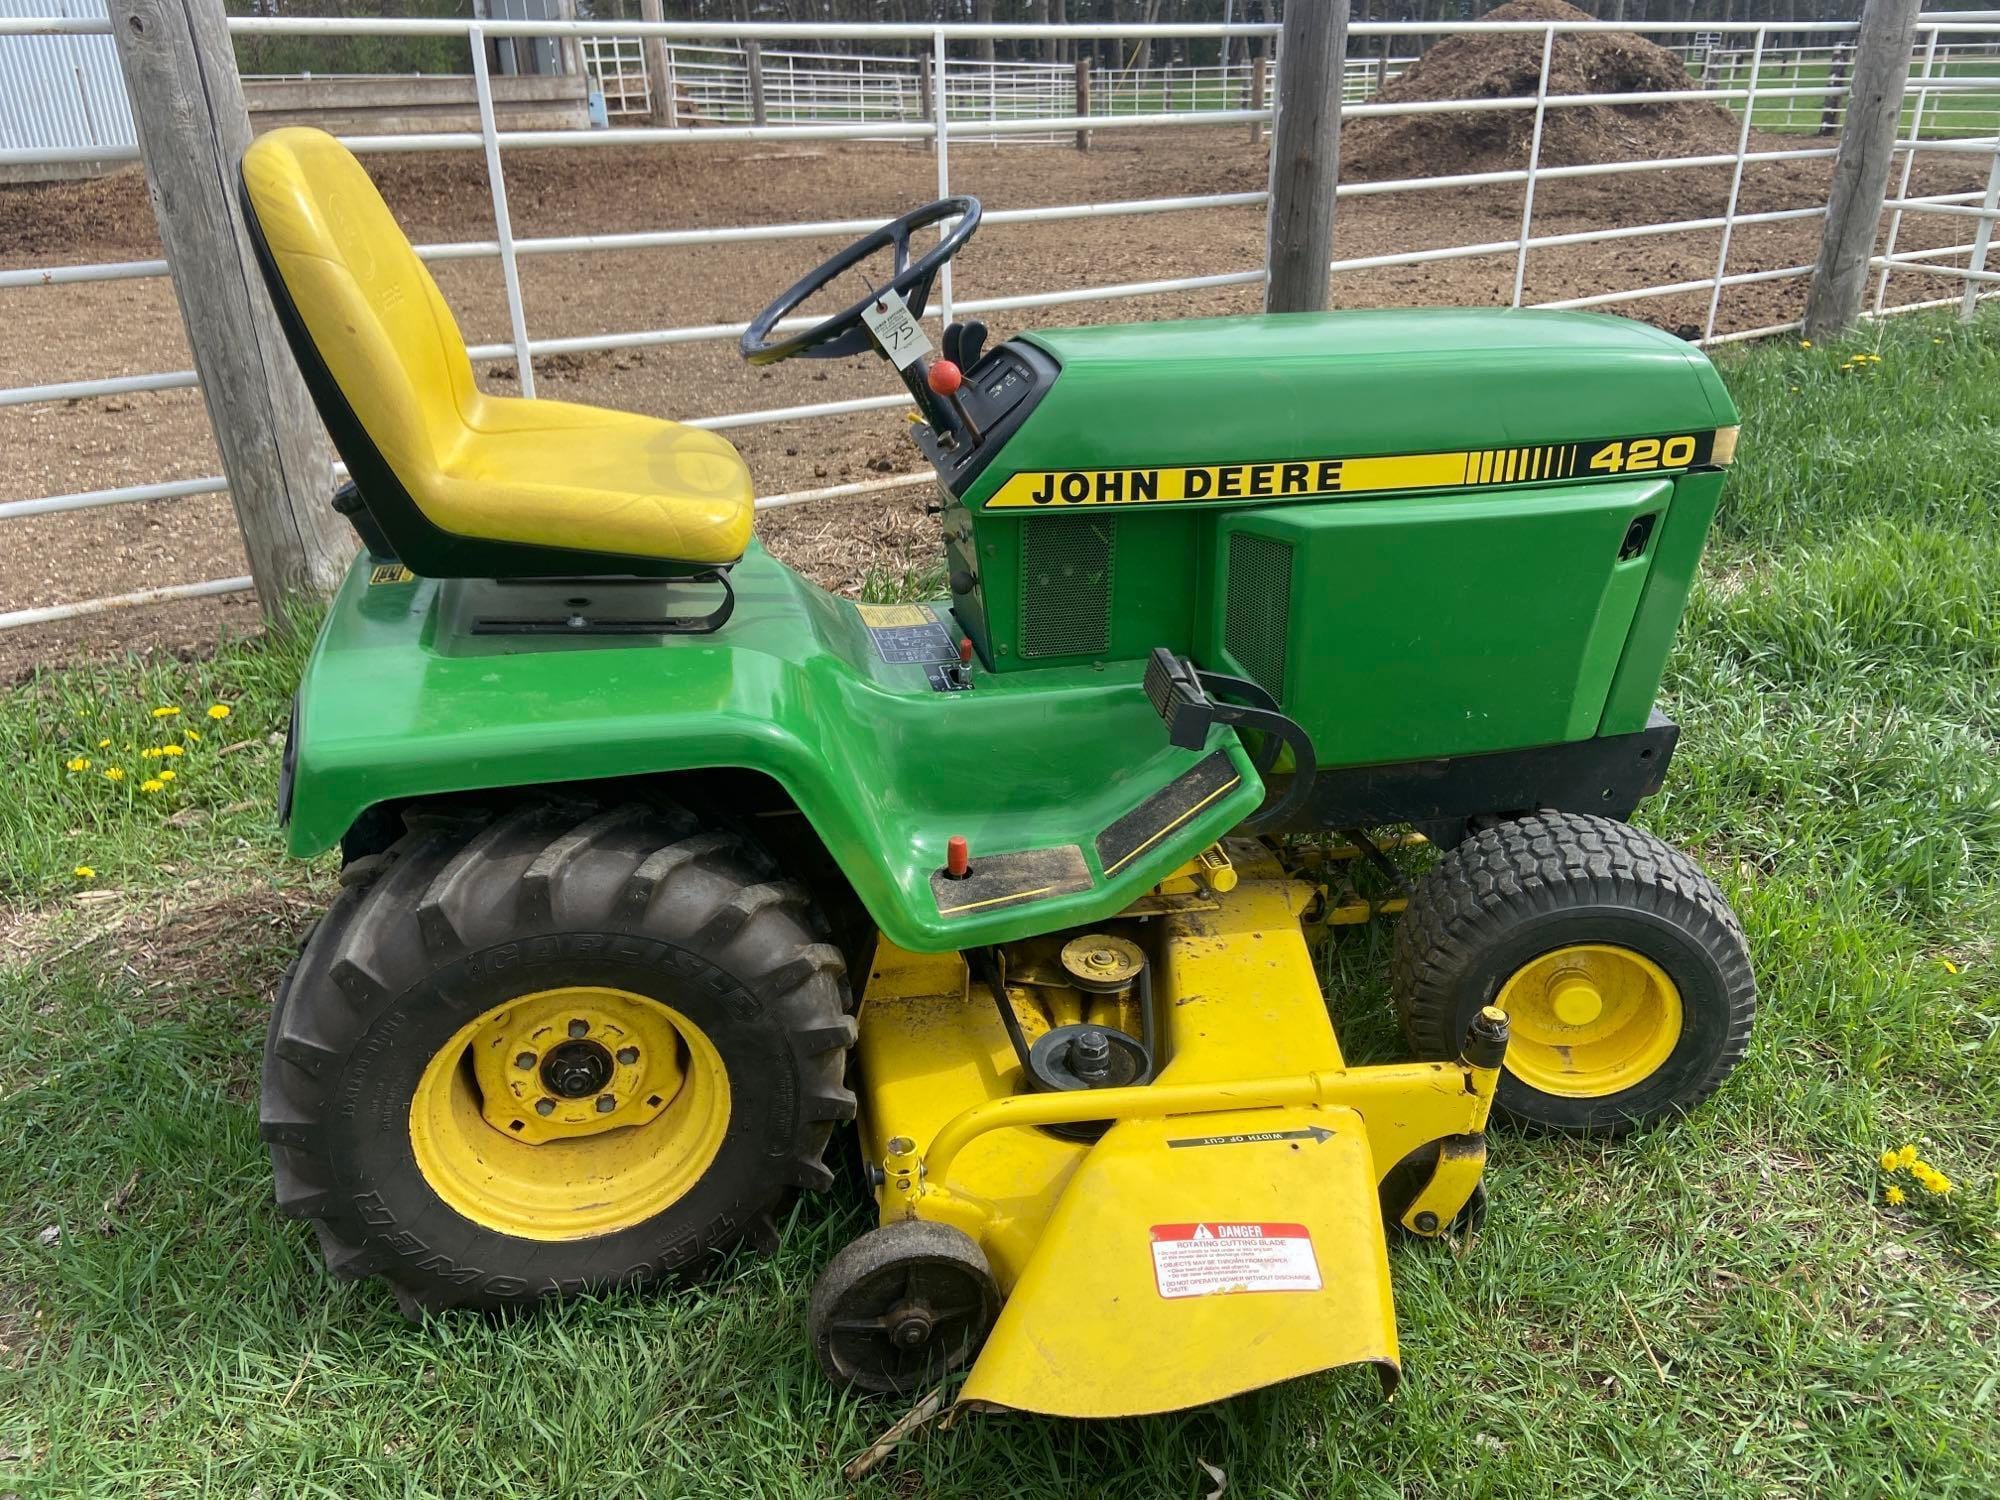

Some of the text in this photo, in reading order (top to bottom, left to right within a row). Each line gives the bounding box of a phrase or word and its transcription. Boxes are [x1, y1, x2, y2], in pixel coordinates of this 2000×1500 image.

[886, 320, 914, 350] 75
[1589, 436, 1696, 473] 420
[1031, 461, 1343, 505] JOHN DEERE
[1230, 1135, 1244, 1143] OF
[1247, 1133, 1283, 1141] WIDTH
[1217, 1225, 1263, 1238] DANGER
[1176, 1240, 1219, 1248] ROTATING
[1220, 1239, 1257, 1247] CUTTING
[1163, 1260, 1191, 1268] OBJECTS
[1190, 1277, 1219, 1285] OPERATE
